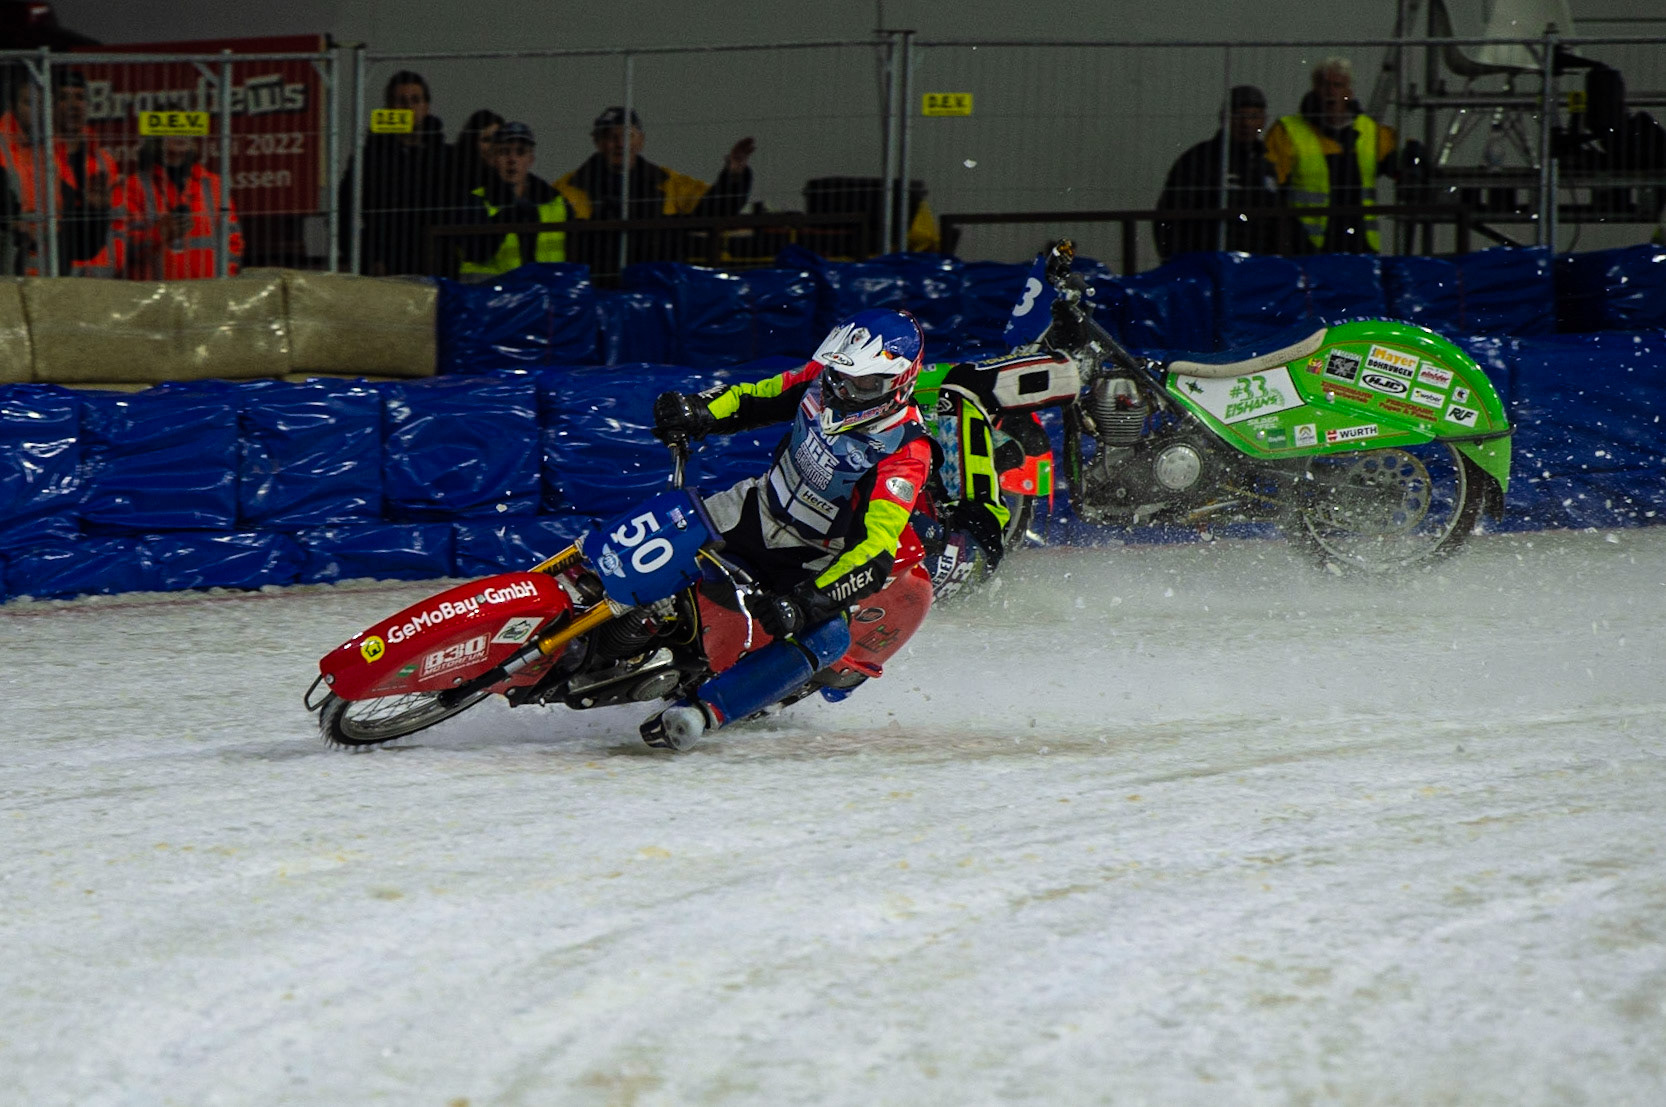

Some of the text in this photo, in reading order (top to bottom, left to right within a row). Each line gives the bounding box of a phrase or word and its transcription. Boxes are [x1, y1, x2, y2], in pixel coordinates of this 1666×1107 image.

[148, 114, 205, 128] D.E.V.
[247, 133, 304, 155] 2022
[230, 170, 291, 189] ssen
[1229, 375, 1269, 401] #33
[1368, 376, 1400, 390] HJC
[805, 427, 840, 473] ICE
[802, 490, 835, 512] Hertz
[610, 511, 674, 574] 50
[387, 581, 539, 643] GeMoBau GmbH
